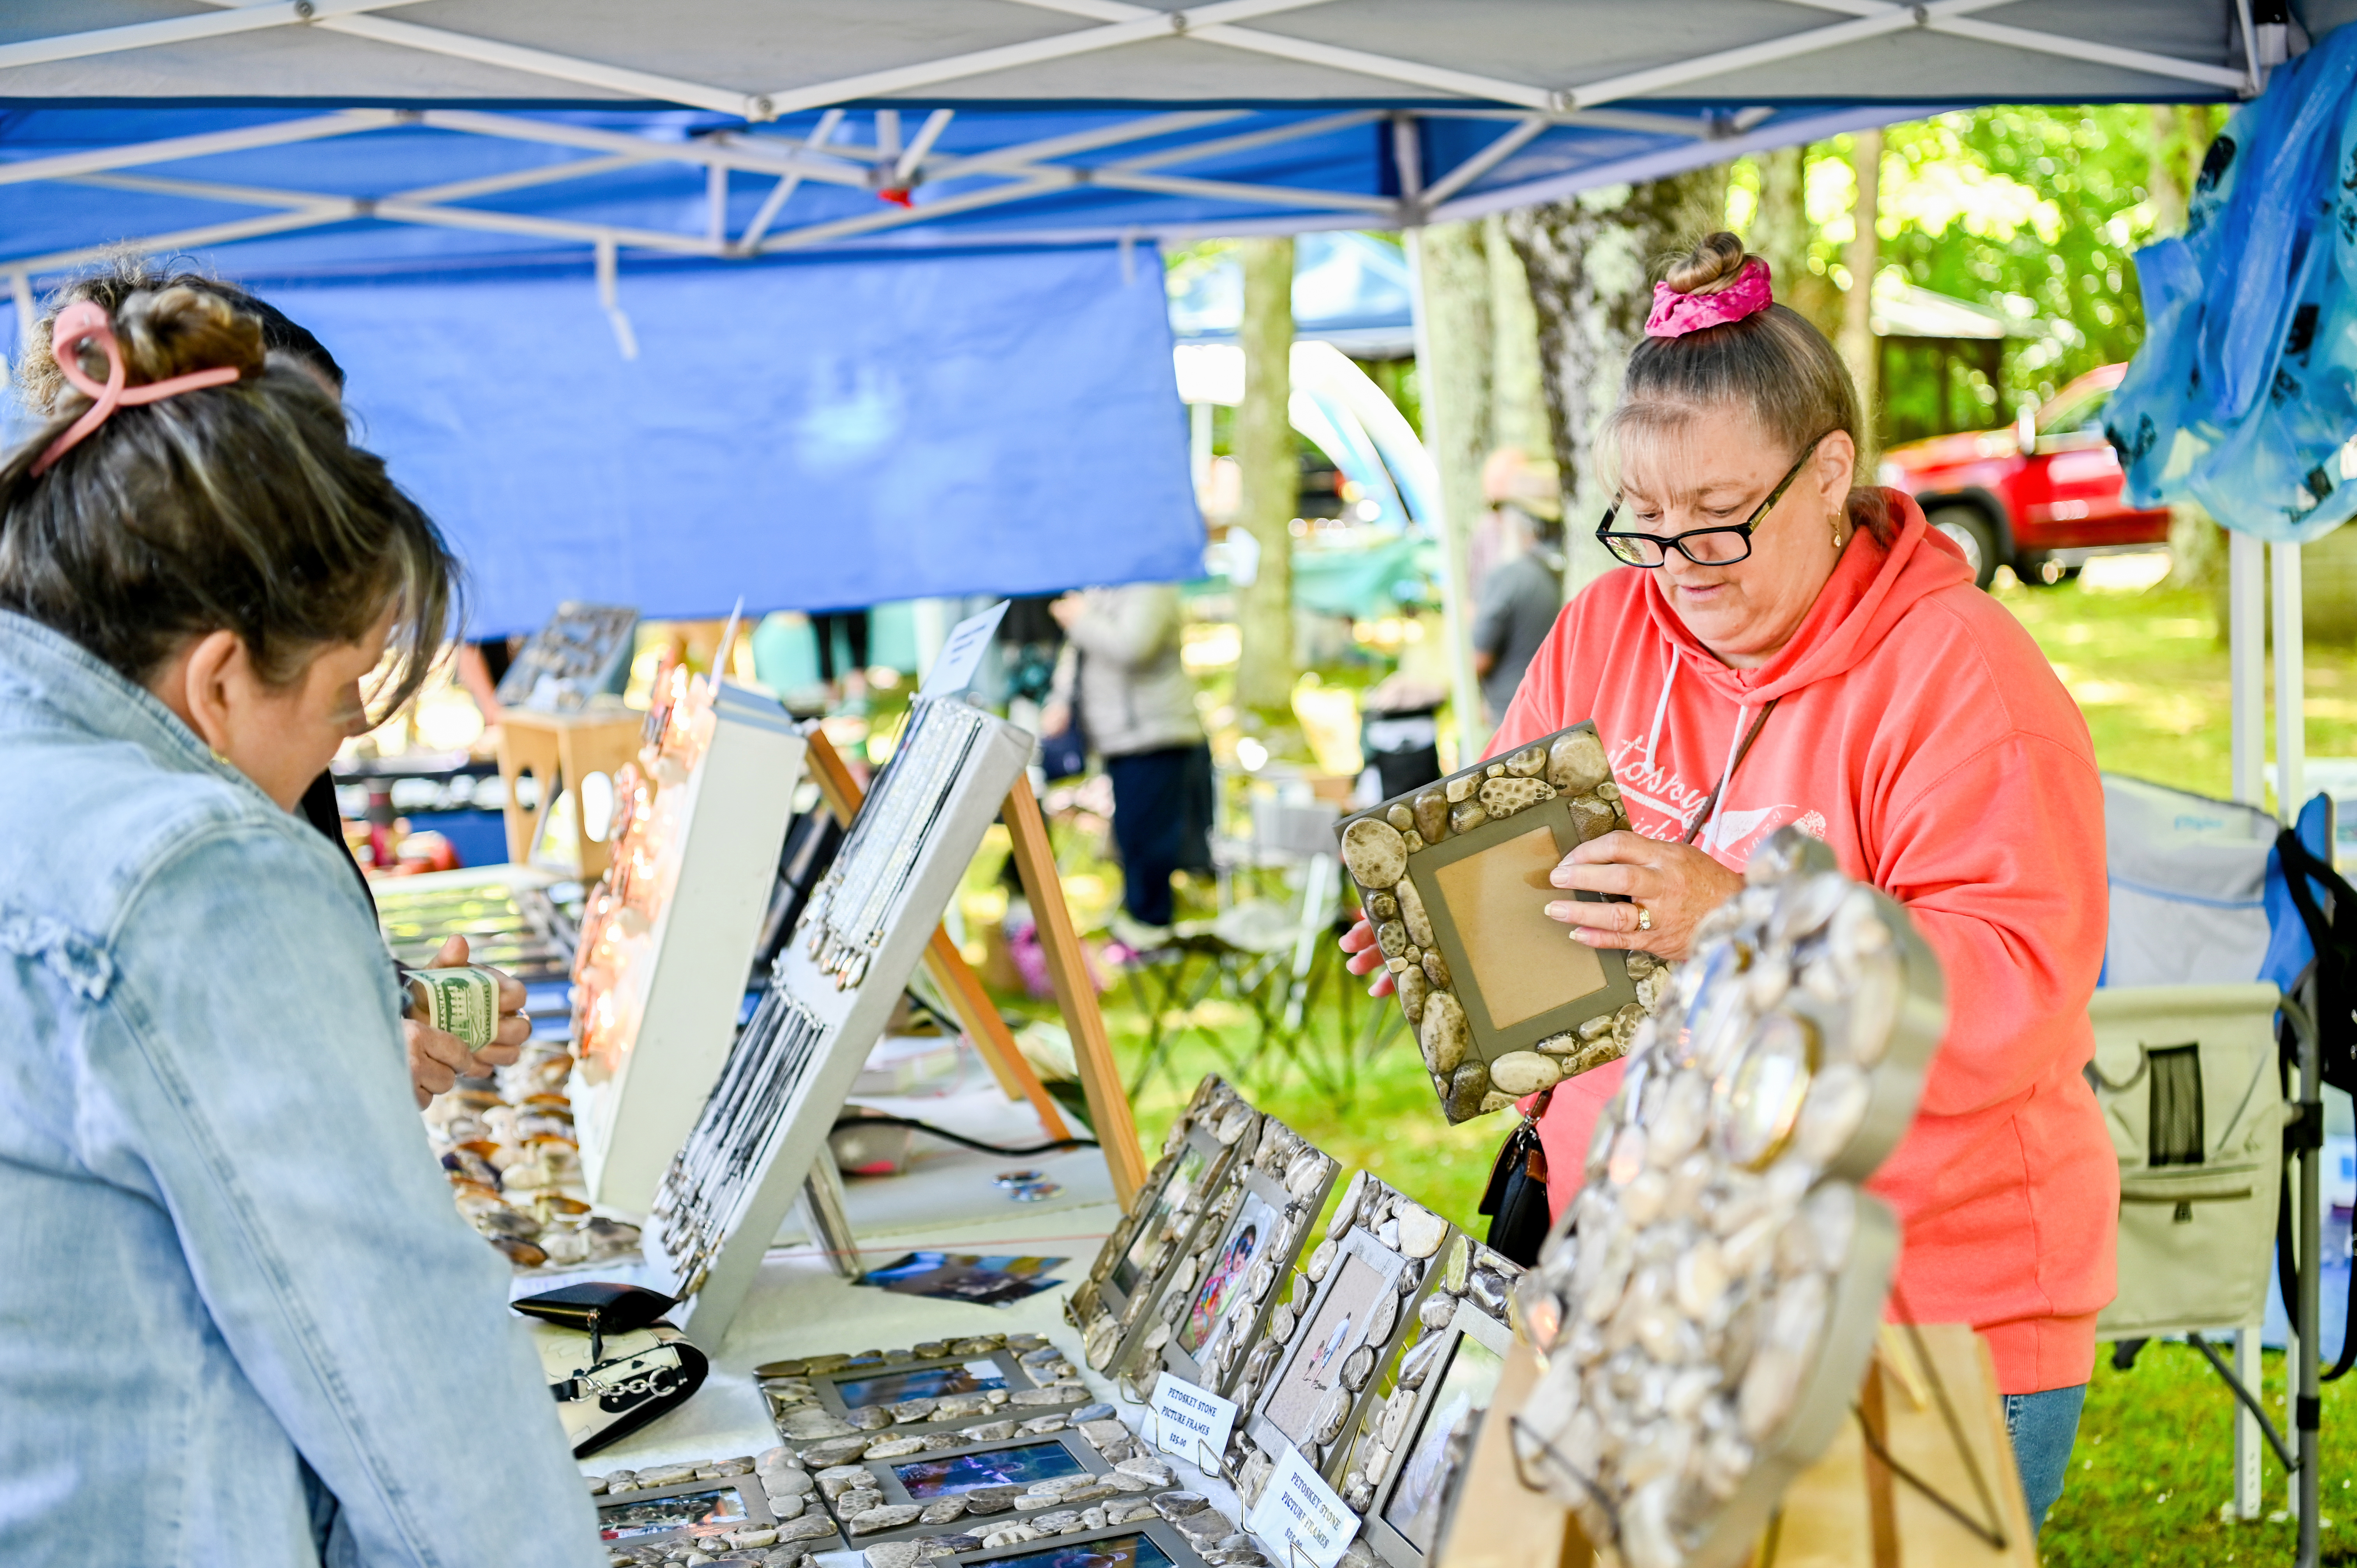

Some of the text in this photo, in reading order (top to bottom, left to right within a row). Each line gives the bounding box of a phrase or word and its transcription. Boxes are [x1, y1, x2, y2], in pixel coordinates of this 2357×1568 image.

[1608, 734, 1710, 829] toskey
[1161, 1406, 1210, 1436] PICTURE FRAMES
[1168, 1387, 1217, 1417] PETOSKEY STONE
[1170, 1432, 1186, 1447] $25.00
[1282, 1491, 1329, 1549] PICTURE FRAMES
[1291, 1472, 1341, 1531] PETOSKEY STONE
